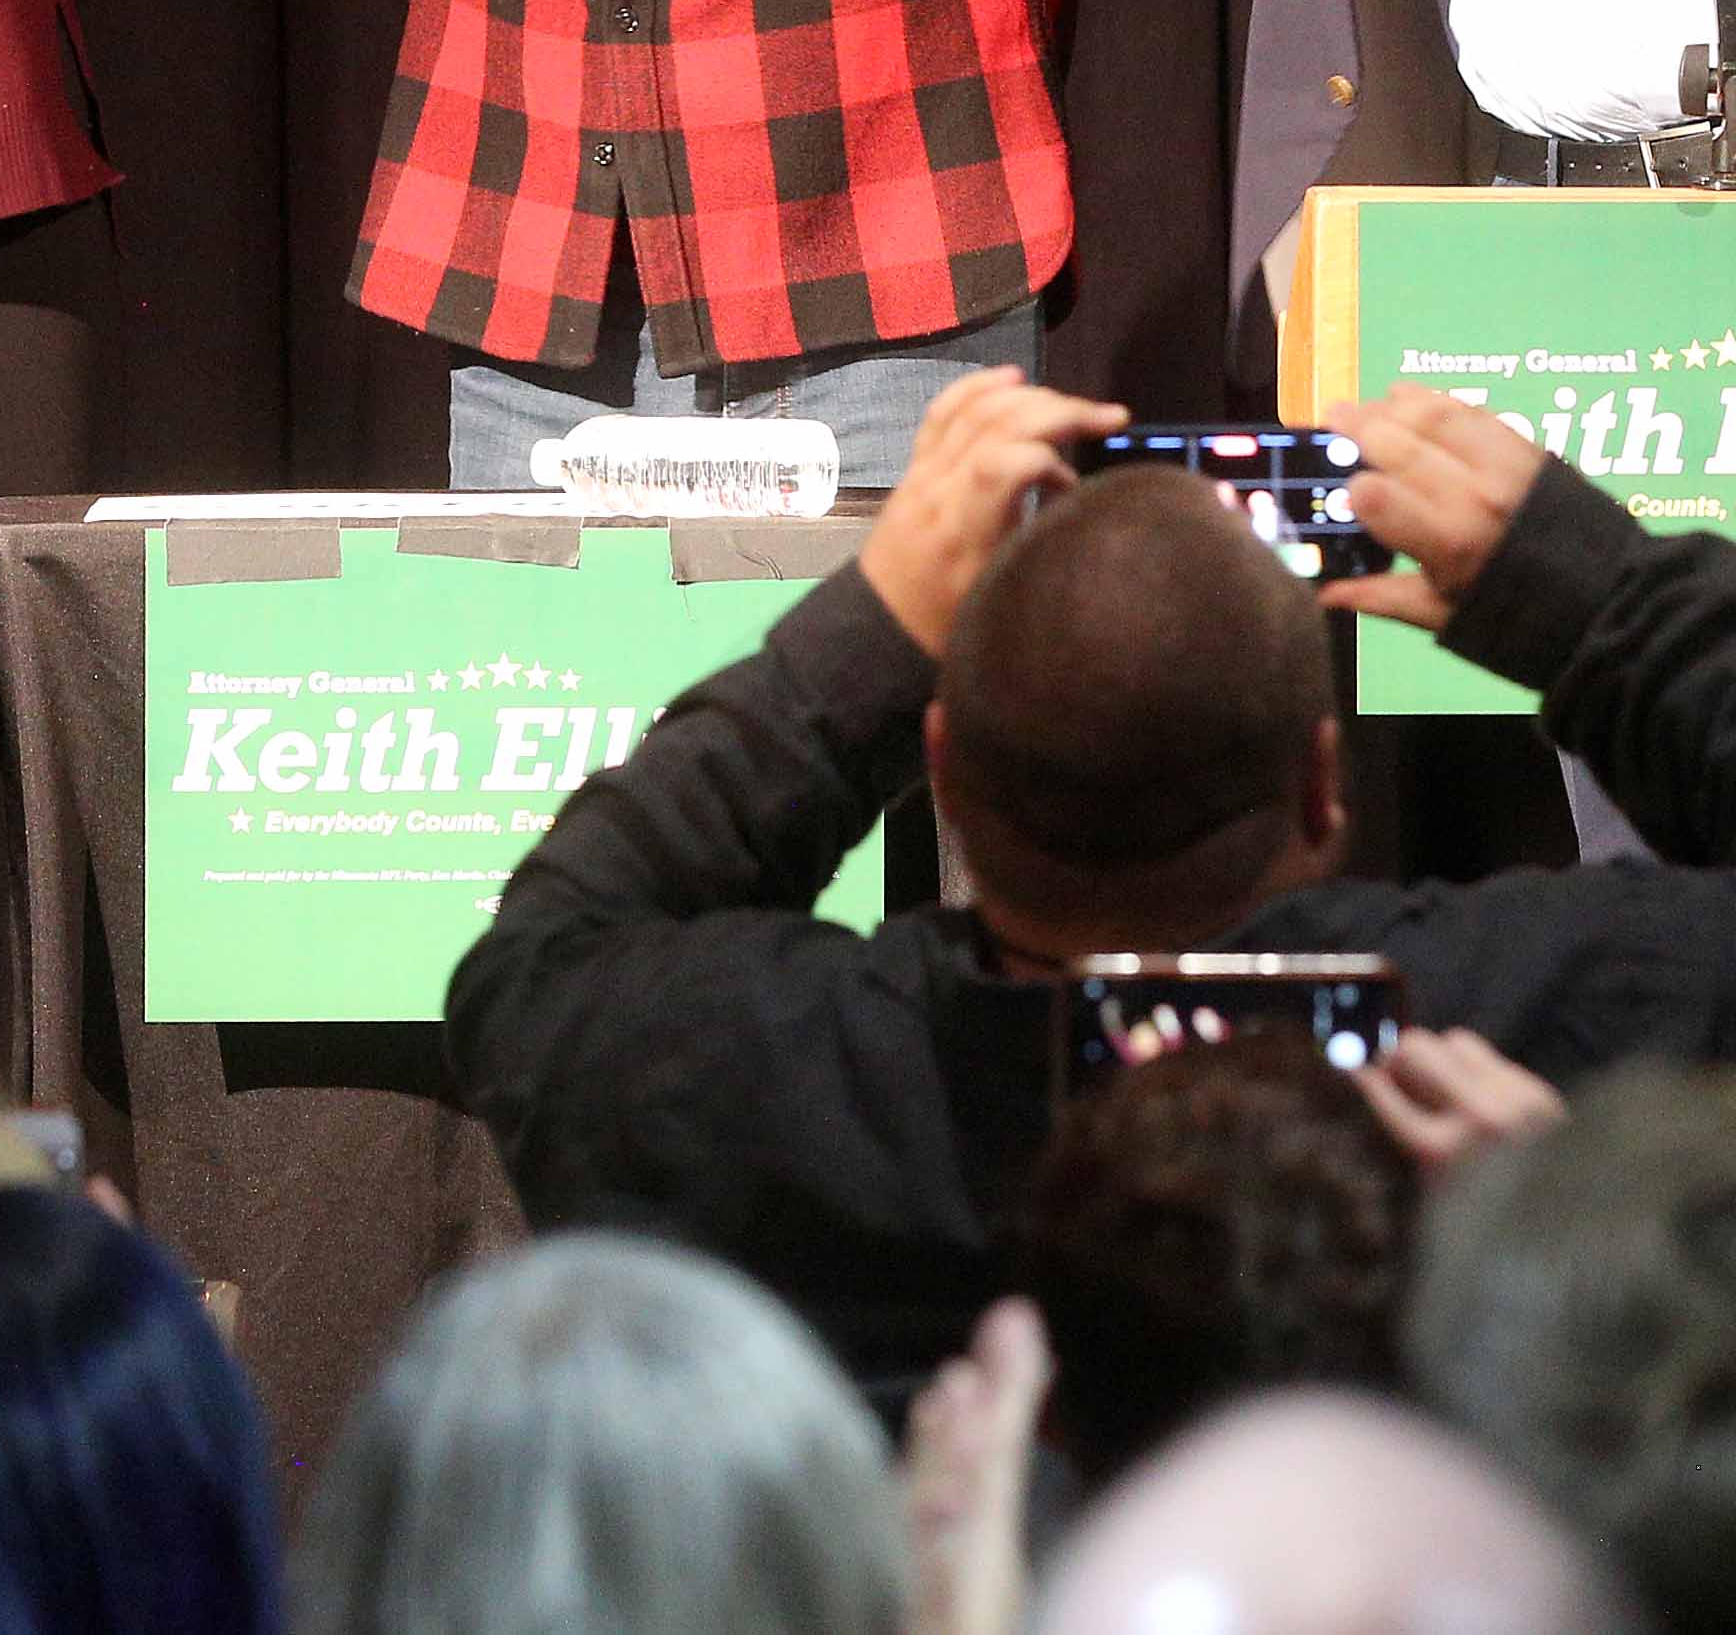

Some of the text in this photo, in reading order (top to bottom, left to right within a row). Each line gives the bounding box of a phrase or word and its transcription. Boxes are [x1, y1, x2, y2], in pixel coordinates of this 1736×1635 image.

[1400, 348, 1638, 378] Attorney General
[1627, 493, 1728, 522] Counts,
[187, 669, 416, 699] Attorney General
[171, 706, 460, 793] Keith
[264, 810, 399, 836] Everybody
[406, 810, 503, 836] Counts,
